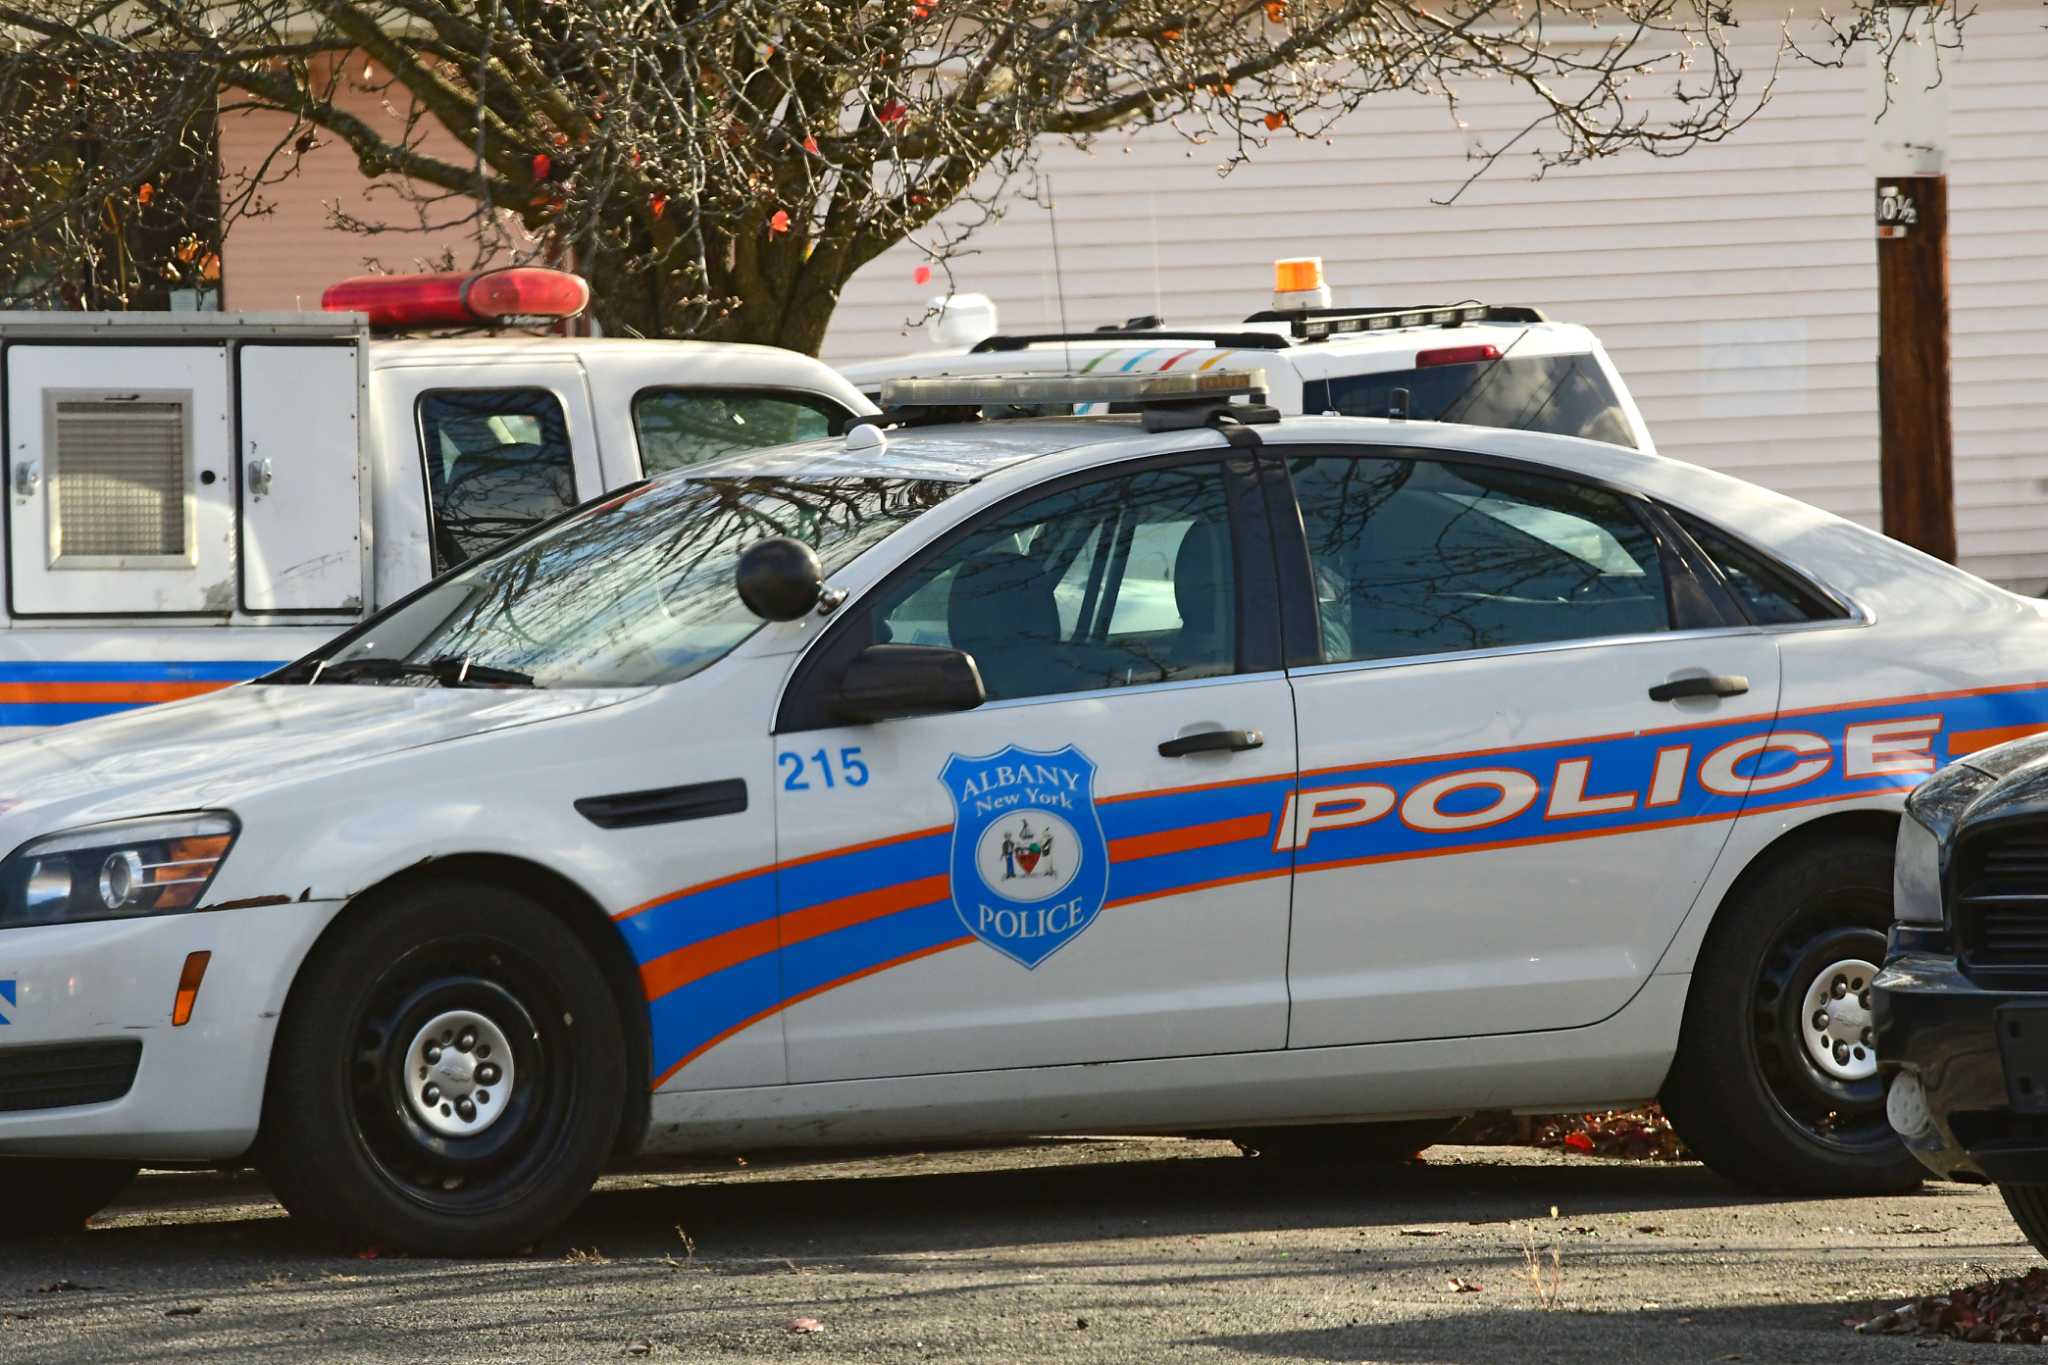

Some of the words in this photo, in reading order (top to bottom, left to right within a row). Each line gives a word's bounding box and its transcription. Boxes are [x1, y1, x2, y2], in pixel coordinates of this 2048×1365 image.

[778, 747, 869, 790] 215
[962, 764, 1080, 801] ALBANY
[1272, 714, 1943, 851] POLICE
[976, 794, 1019, 816] New
[1026, 788, 1072, 809] York
[979, 897, 1084, 938] POLICE
